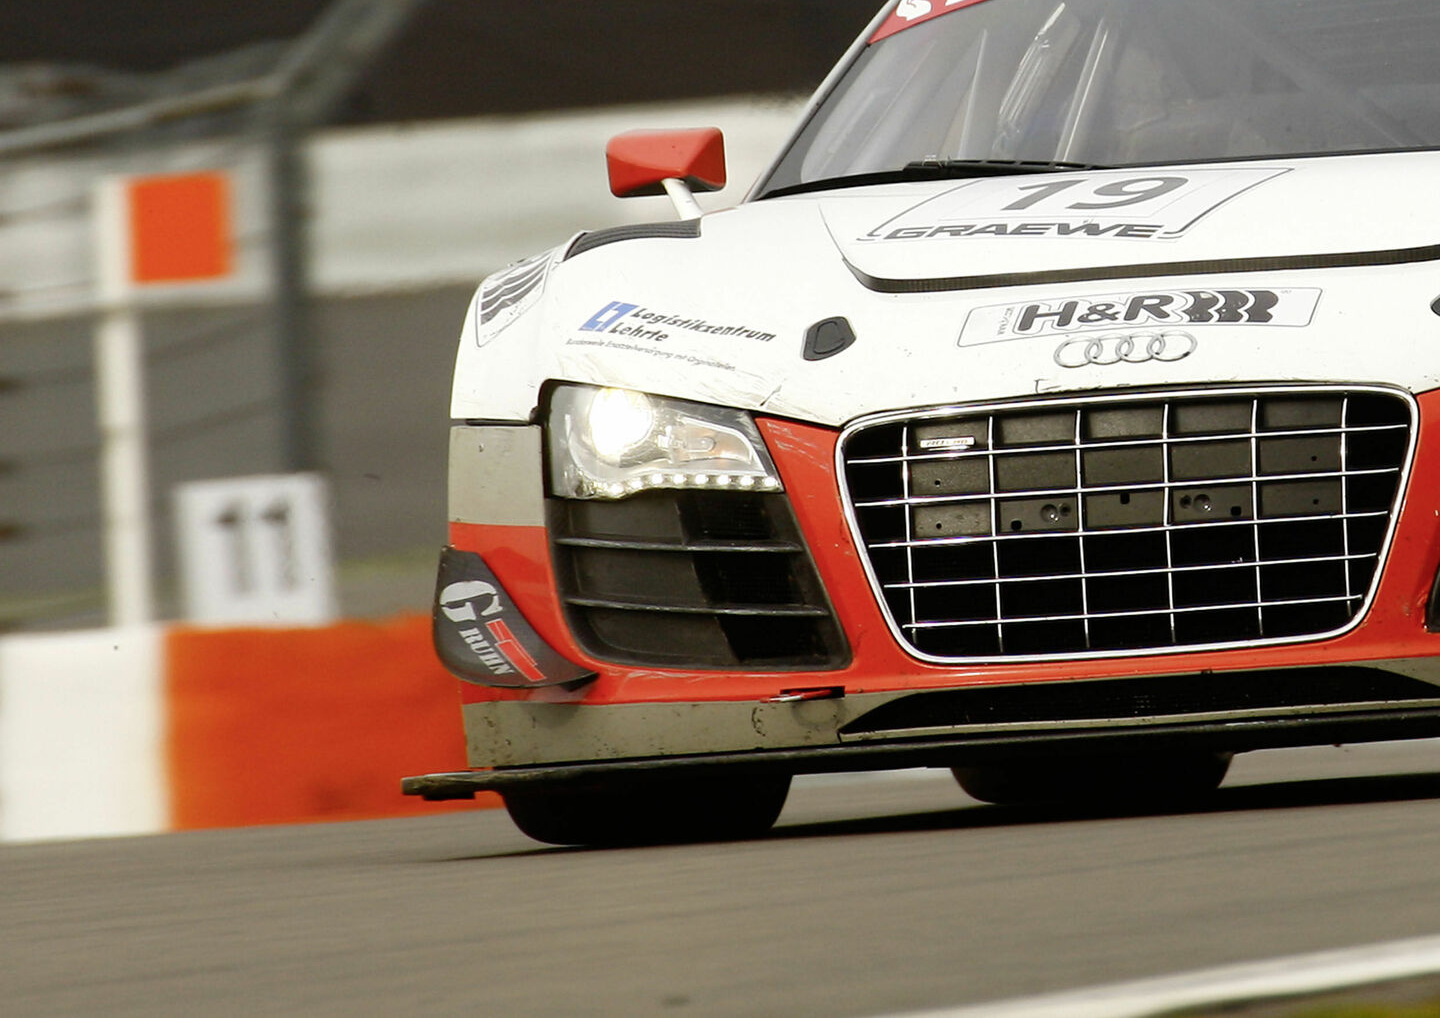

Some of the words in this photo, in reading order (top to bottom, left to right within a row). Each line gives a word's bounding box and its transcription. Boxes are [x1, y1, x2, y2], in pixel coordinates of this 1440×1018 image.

[1000, 176, 1189, 211] 19
[883, 222, 1166, 240] GRAEWE
[631, 308, 776, 342] Logistikzentrum
[1017, 293, 1175, 332] H&R
[609, 322, 669, 342] Lehrte
